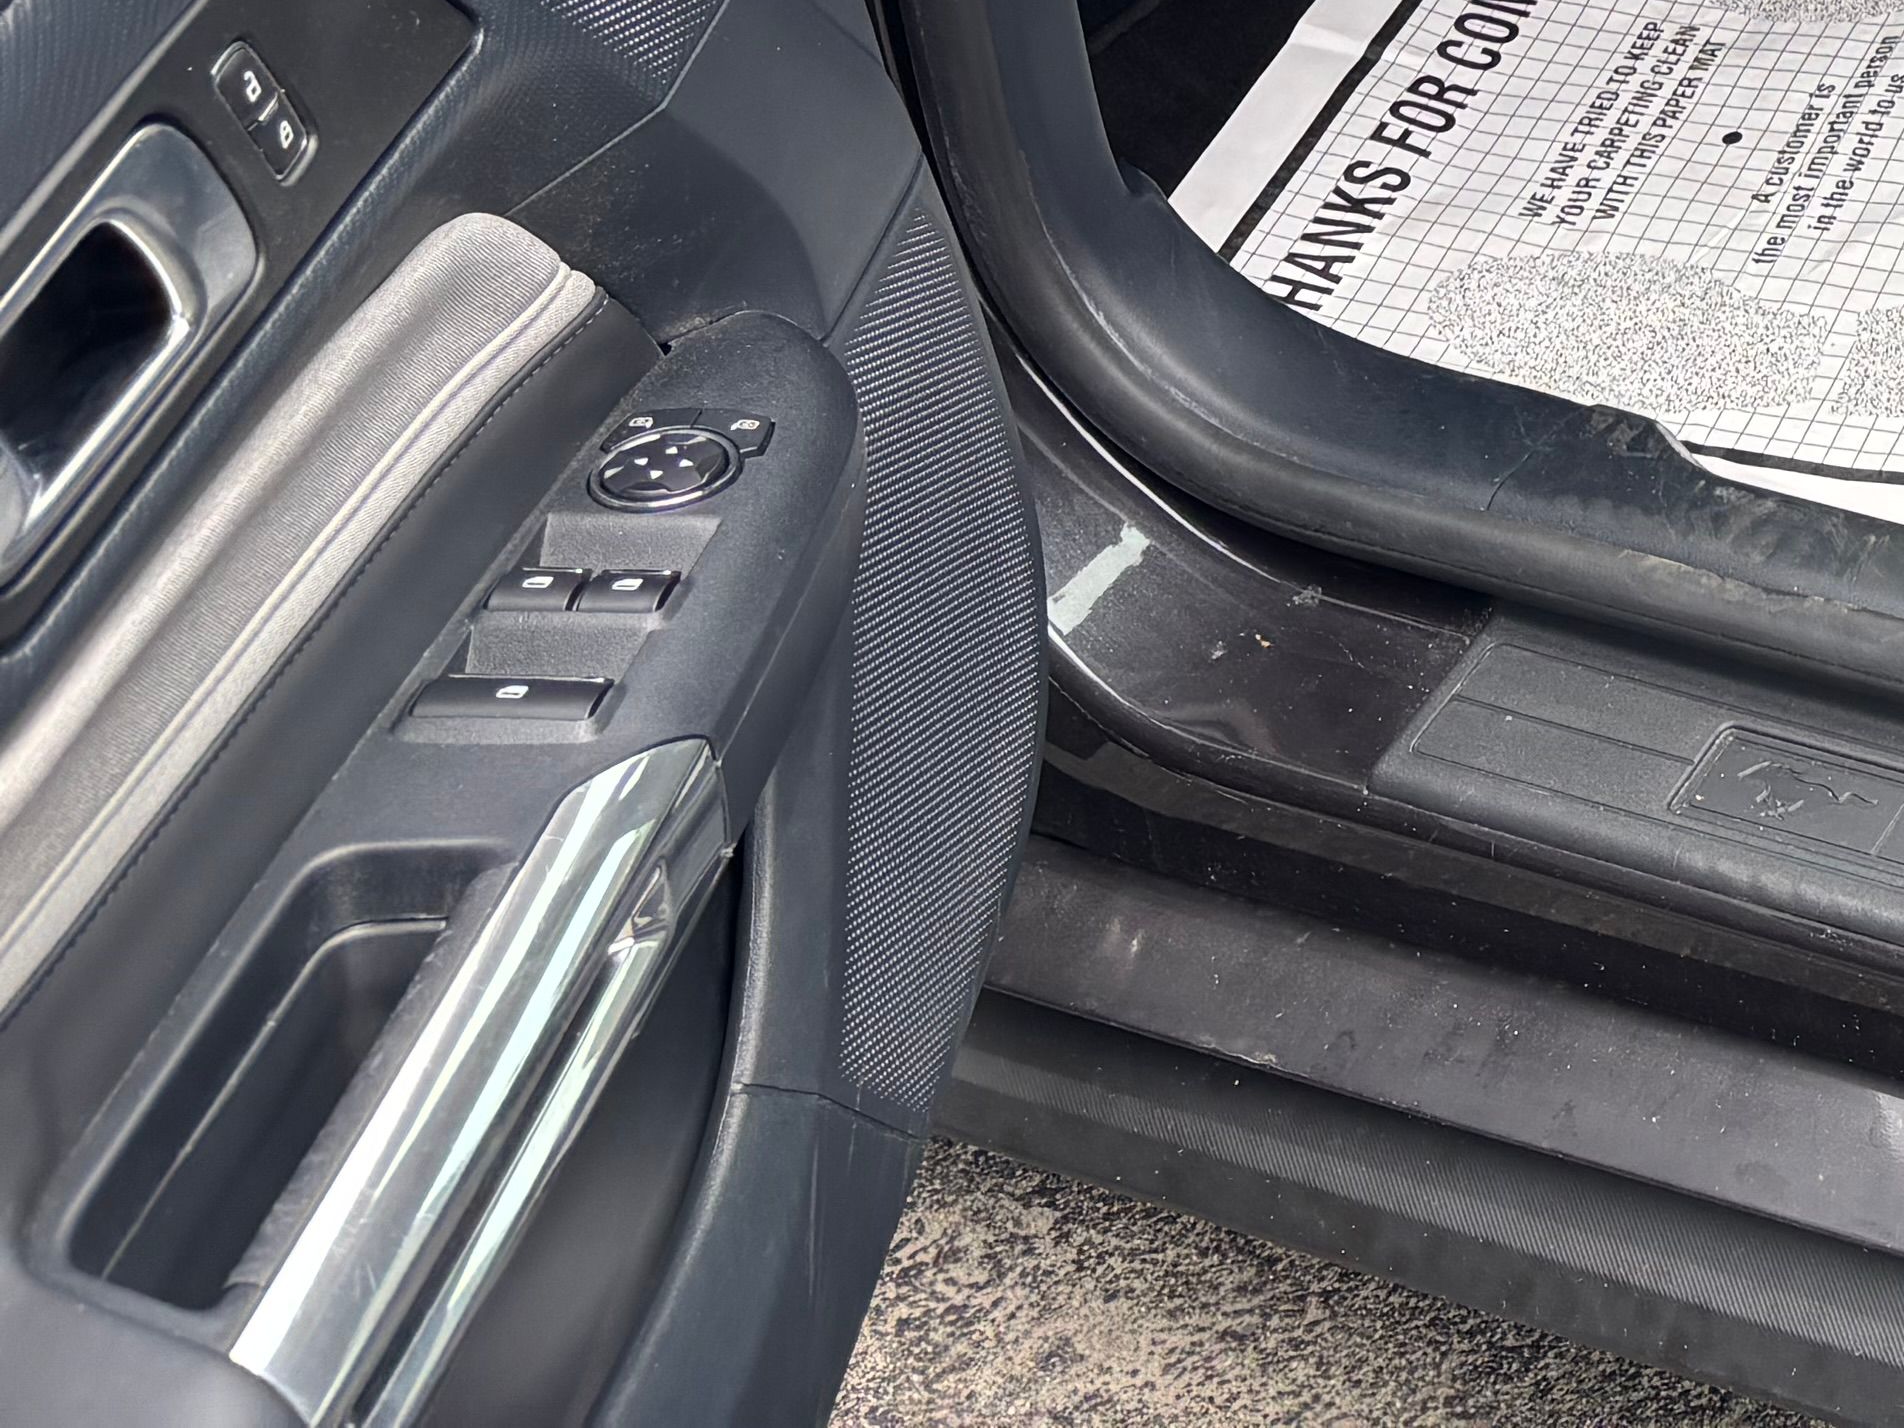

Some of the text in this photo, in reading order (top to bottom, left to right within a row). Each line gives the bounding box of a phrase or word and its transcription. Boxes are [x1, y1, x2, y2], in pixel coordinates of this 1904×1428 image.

[1518, 21, 1664, 218] WE HAVE TRIED TO KEEP
[1551, 24, 1700, 226] YOUR CARPETING CLEAN
[1593, 39, 1726, 221] WITH THIS PAPER MAT
[1751, 82, 1837, 204] A customer is
[1752, 35, 1900, 264] the most important person
[1843, 120, 1885, 174] world
[1868, 99, 1897, 118] to
[1270, 160, 1412, 312] HANKS
[1370, 75, 1480, 158] FOR
[1807, 214, 1837, 231] in
[1821, 179, 1855, 208] the
